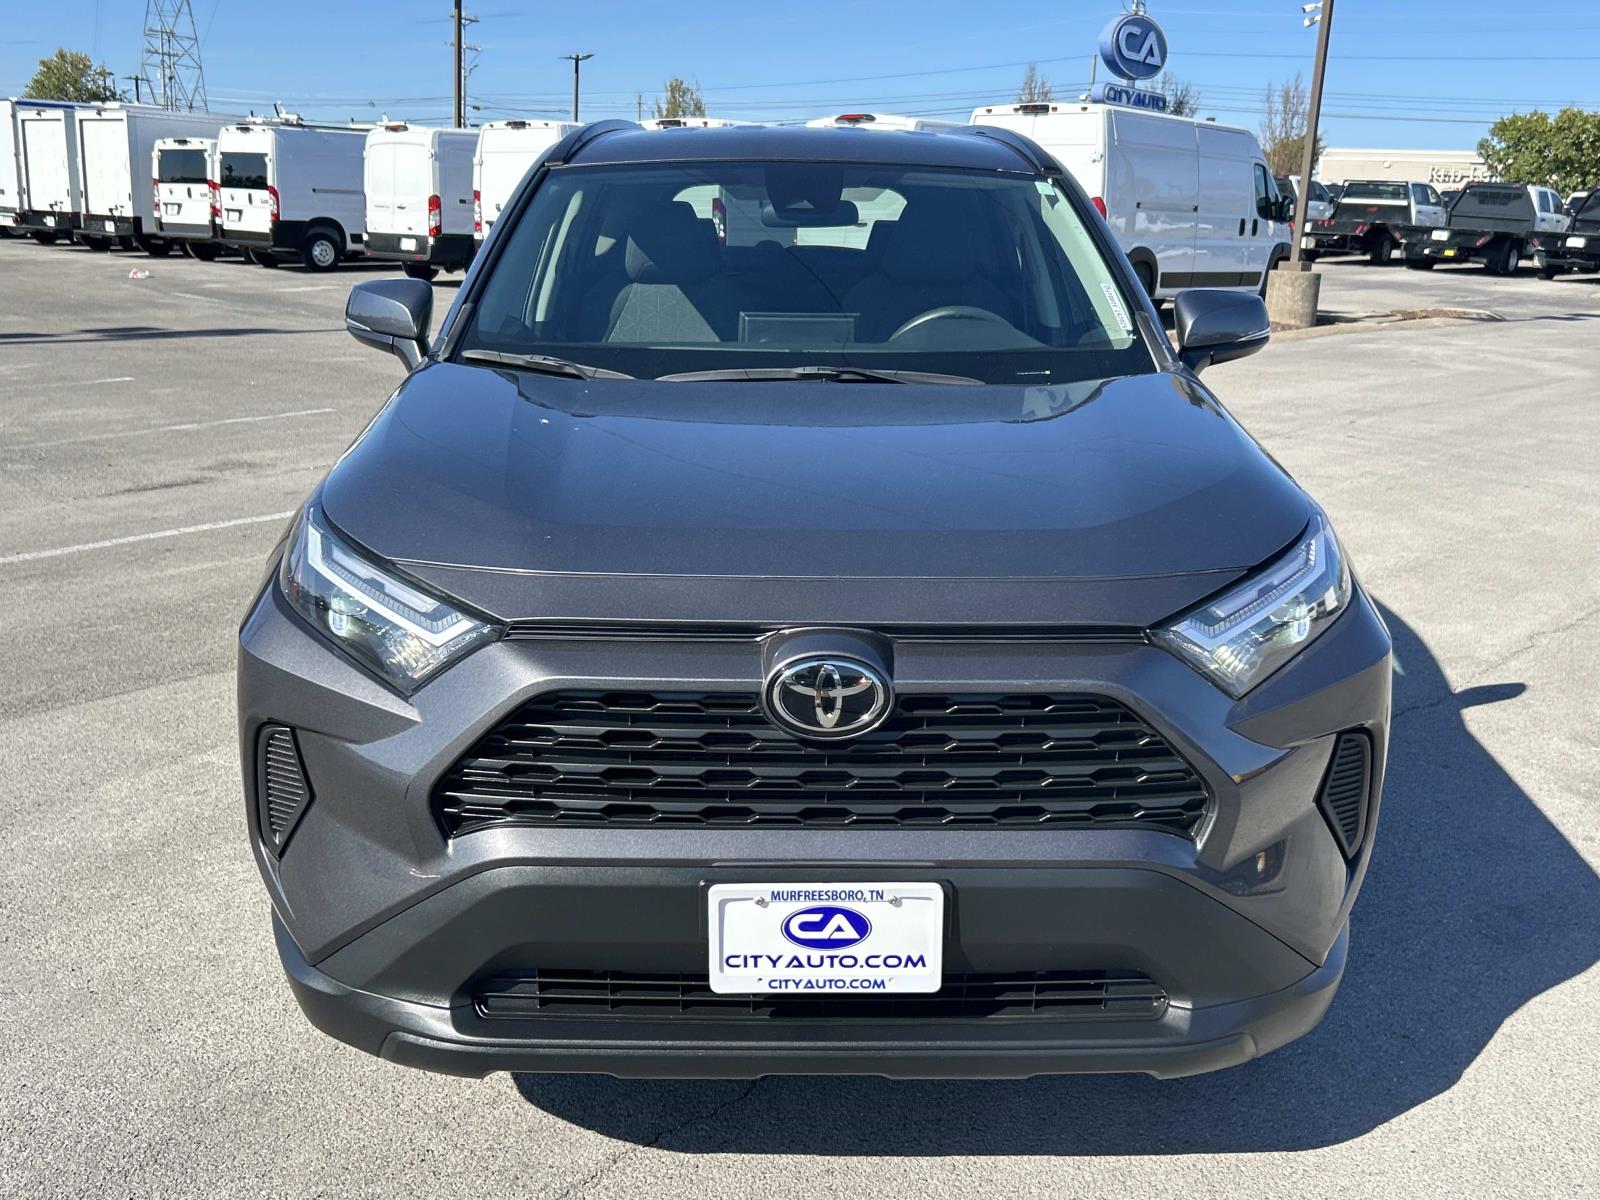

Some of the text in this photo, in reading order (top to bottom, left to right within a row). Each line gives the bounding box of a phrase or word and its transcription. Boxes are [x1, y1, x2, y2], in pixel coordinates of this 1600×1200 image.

[770, 890, 884, 902] MURFREESBORO, TN
[789, 913, 861, 940] CA
[725, 954, 927, 969] CITYAUTO.COM
[768, 979, 886, 990] CITYAUTO.COM
